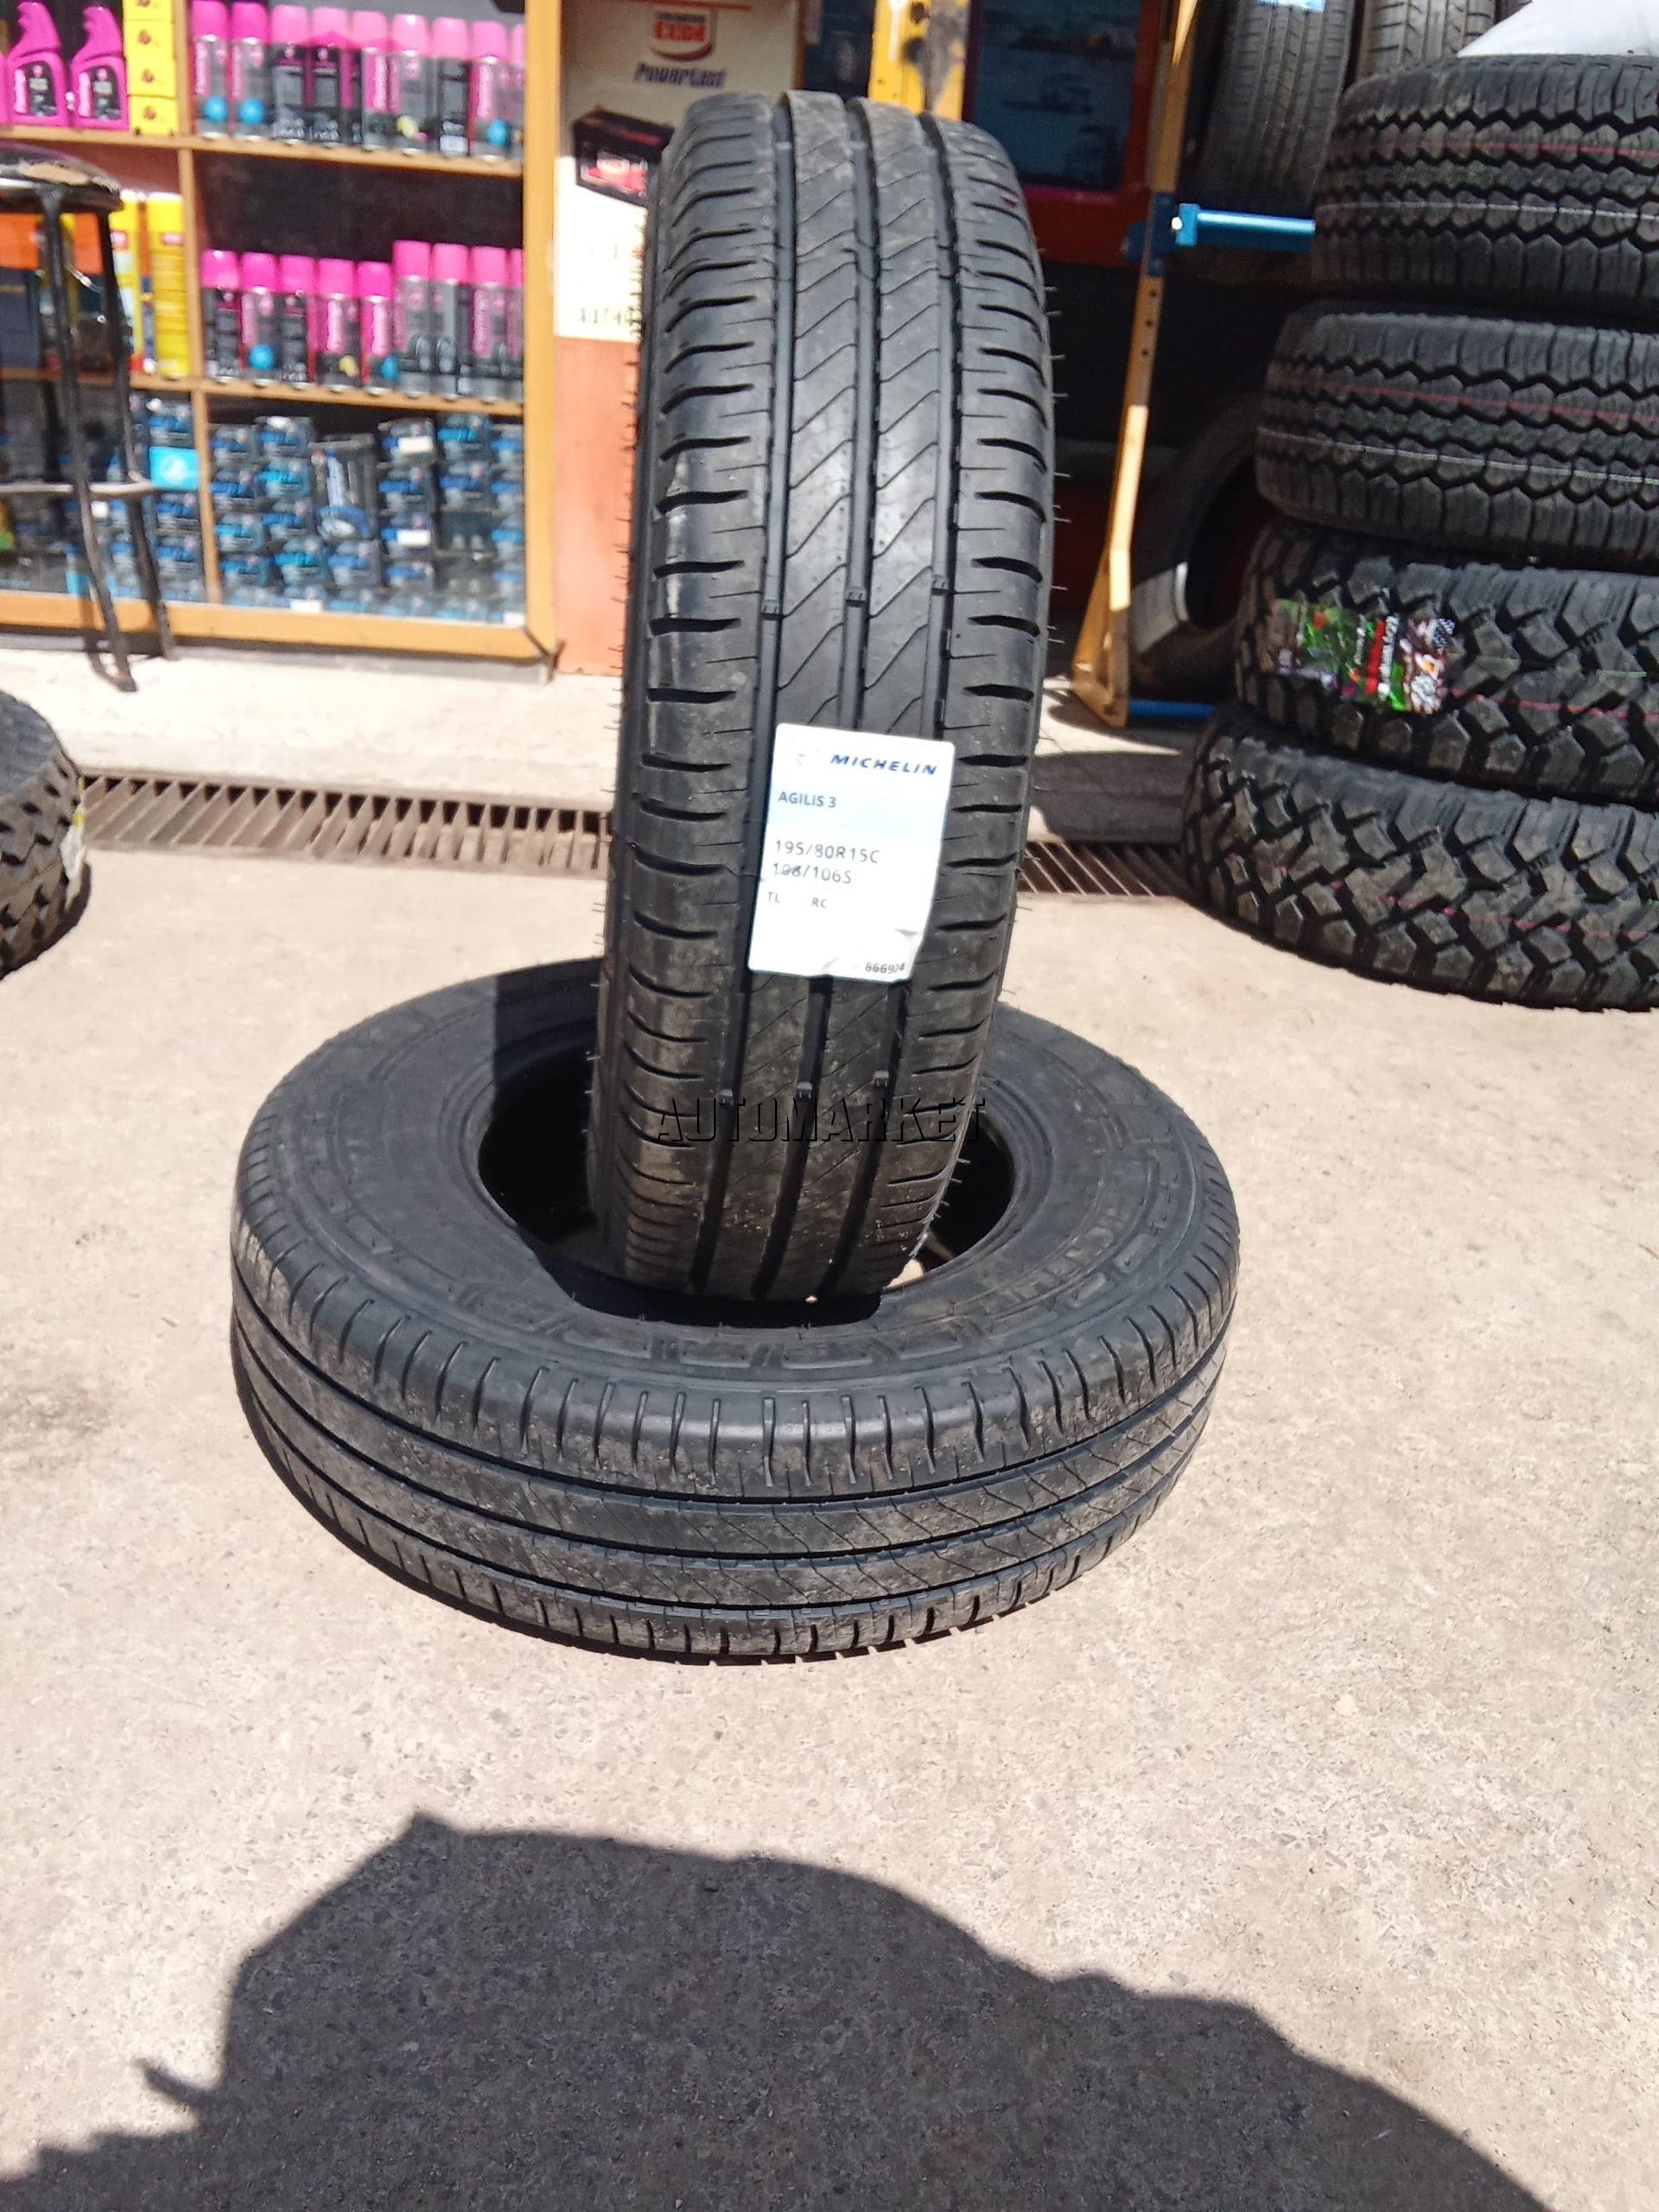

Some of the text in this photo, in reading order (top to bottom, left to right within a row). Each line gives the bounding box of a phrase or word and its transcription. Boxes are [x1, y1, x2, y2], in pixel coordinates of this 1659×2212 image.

[830, 754, 938, 775] MICHELIN
[778, 791, 836, 808] AGILIS 3
[776, 840, 880, 863] 195/80R15C
[767, 891, 828, 908] TL RC
